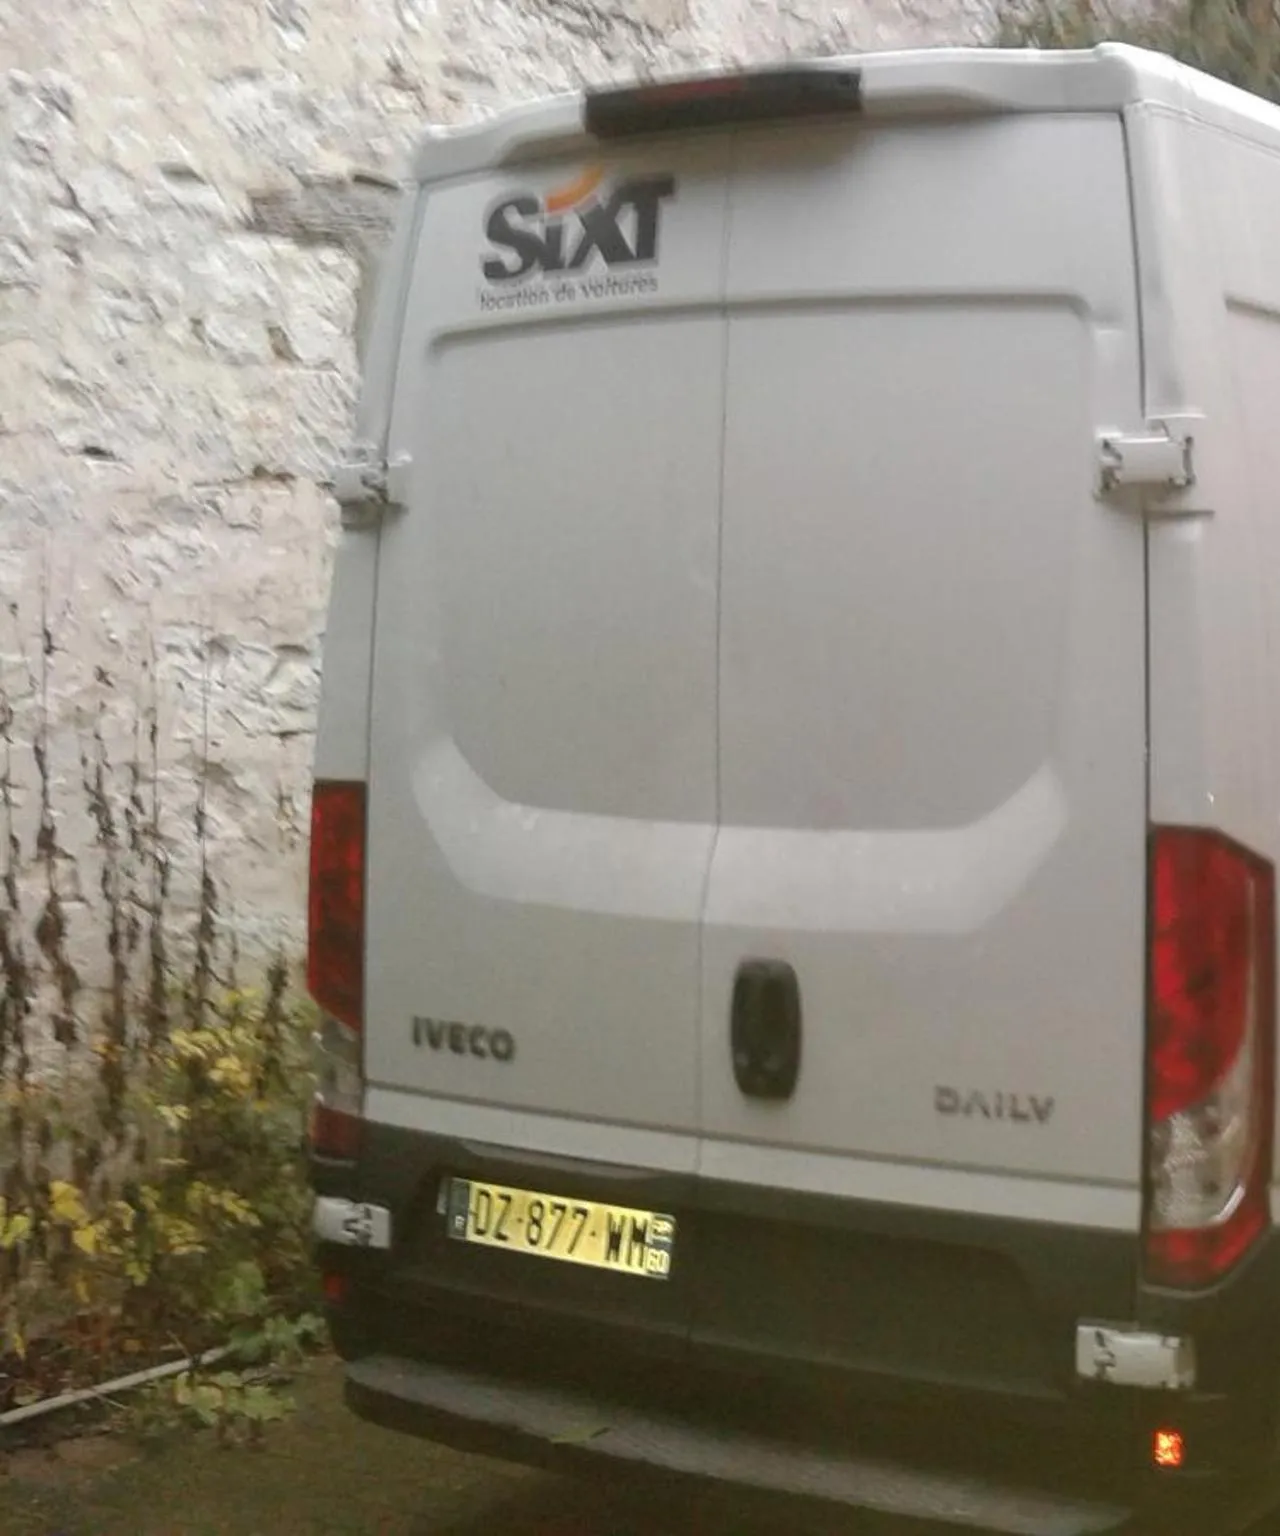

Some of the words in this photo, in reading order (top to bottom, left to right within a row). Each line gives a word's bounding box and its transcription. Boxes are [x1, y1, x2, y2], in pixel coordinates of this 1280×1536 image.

[480, 287, 549, 311] location
[555, 281, 576, 303] de
[581, 272, 658, 299] voitures
[412, 1015, 515, 1064] IVECO
[934, 1085, 1056, 1124] DAILY
